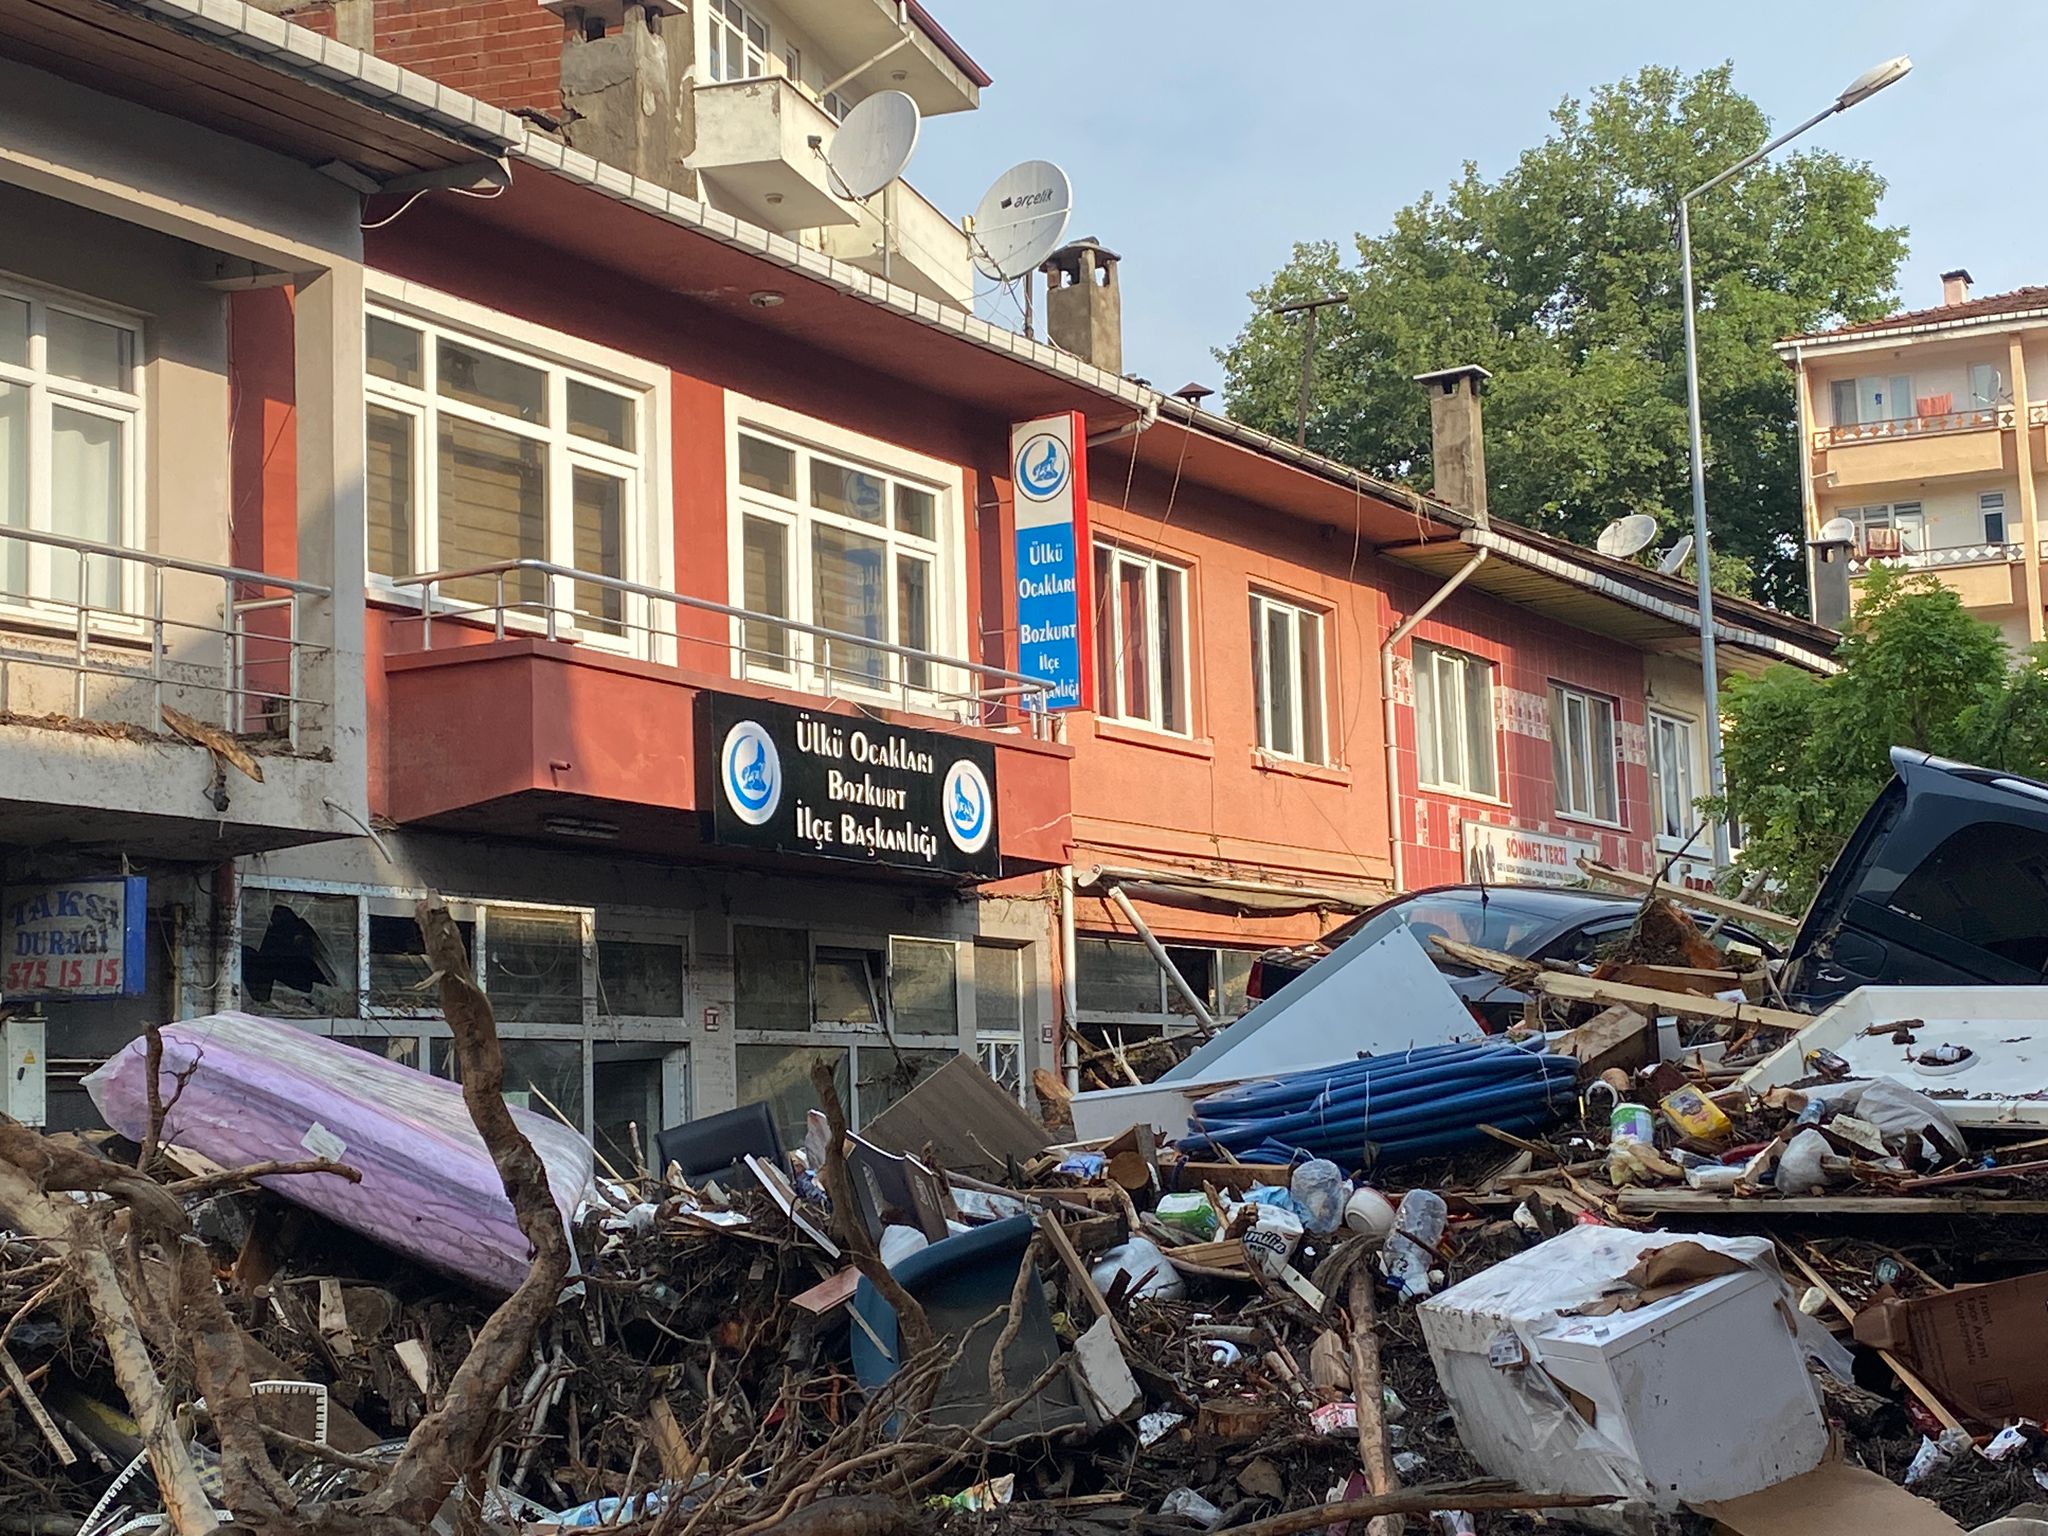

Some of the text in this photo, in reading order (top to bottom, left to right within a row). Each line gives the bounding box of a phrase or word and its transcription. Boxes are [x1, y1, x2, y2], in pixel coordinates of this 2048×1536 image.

[1014, 188, 1054, 208] arçelik
[1020, 619, 1076, 645] Bozkurt
[796, 713, 843, 758] Ülkü
[828, 770, 907, 810] Bozkurt
[796, 799, 833, 850] İlçe
[1506, 833, 1542, 862] SÖNMEZ
[7, 958, 120, 990] 575 15 15
